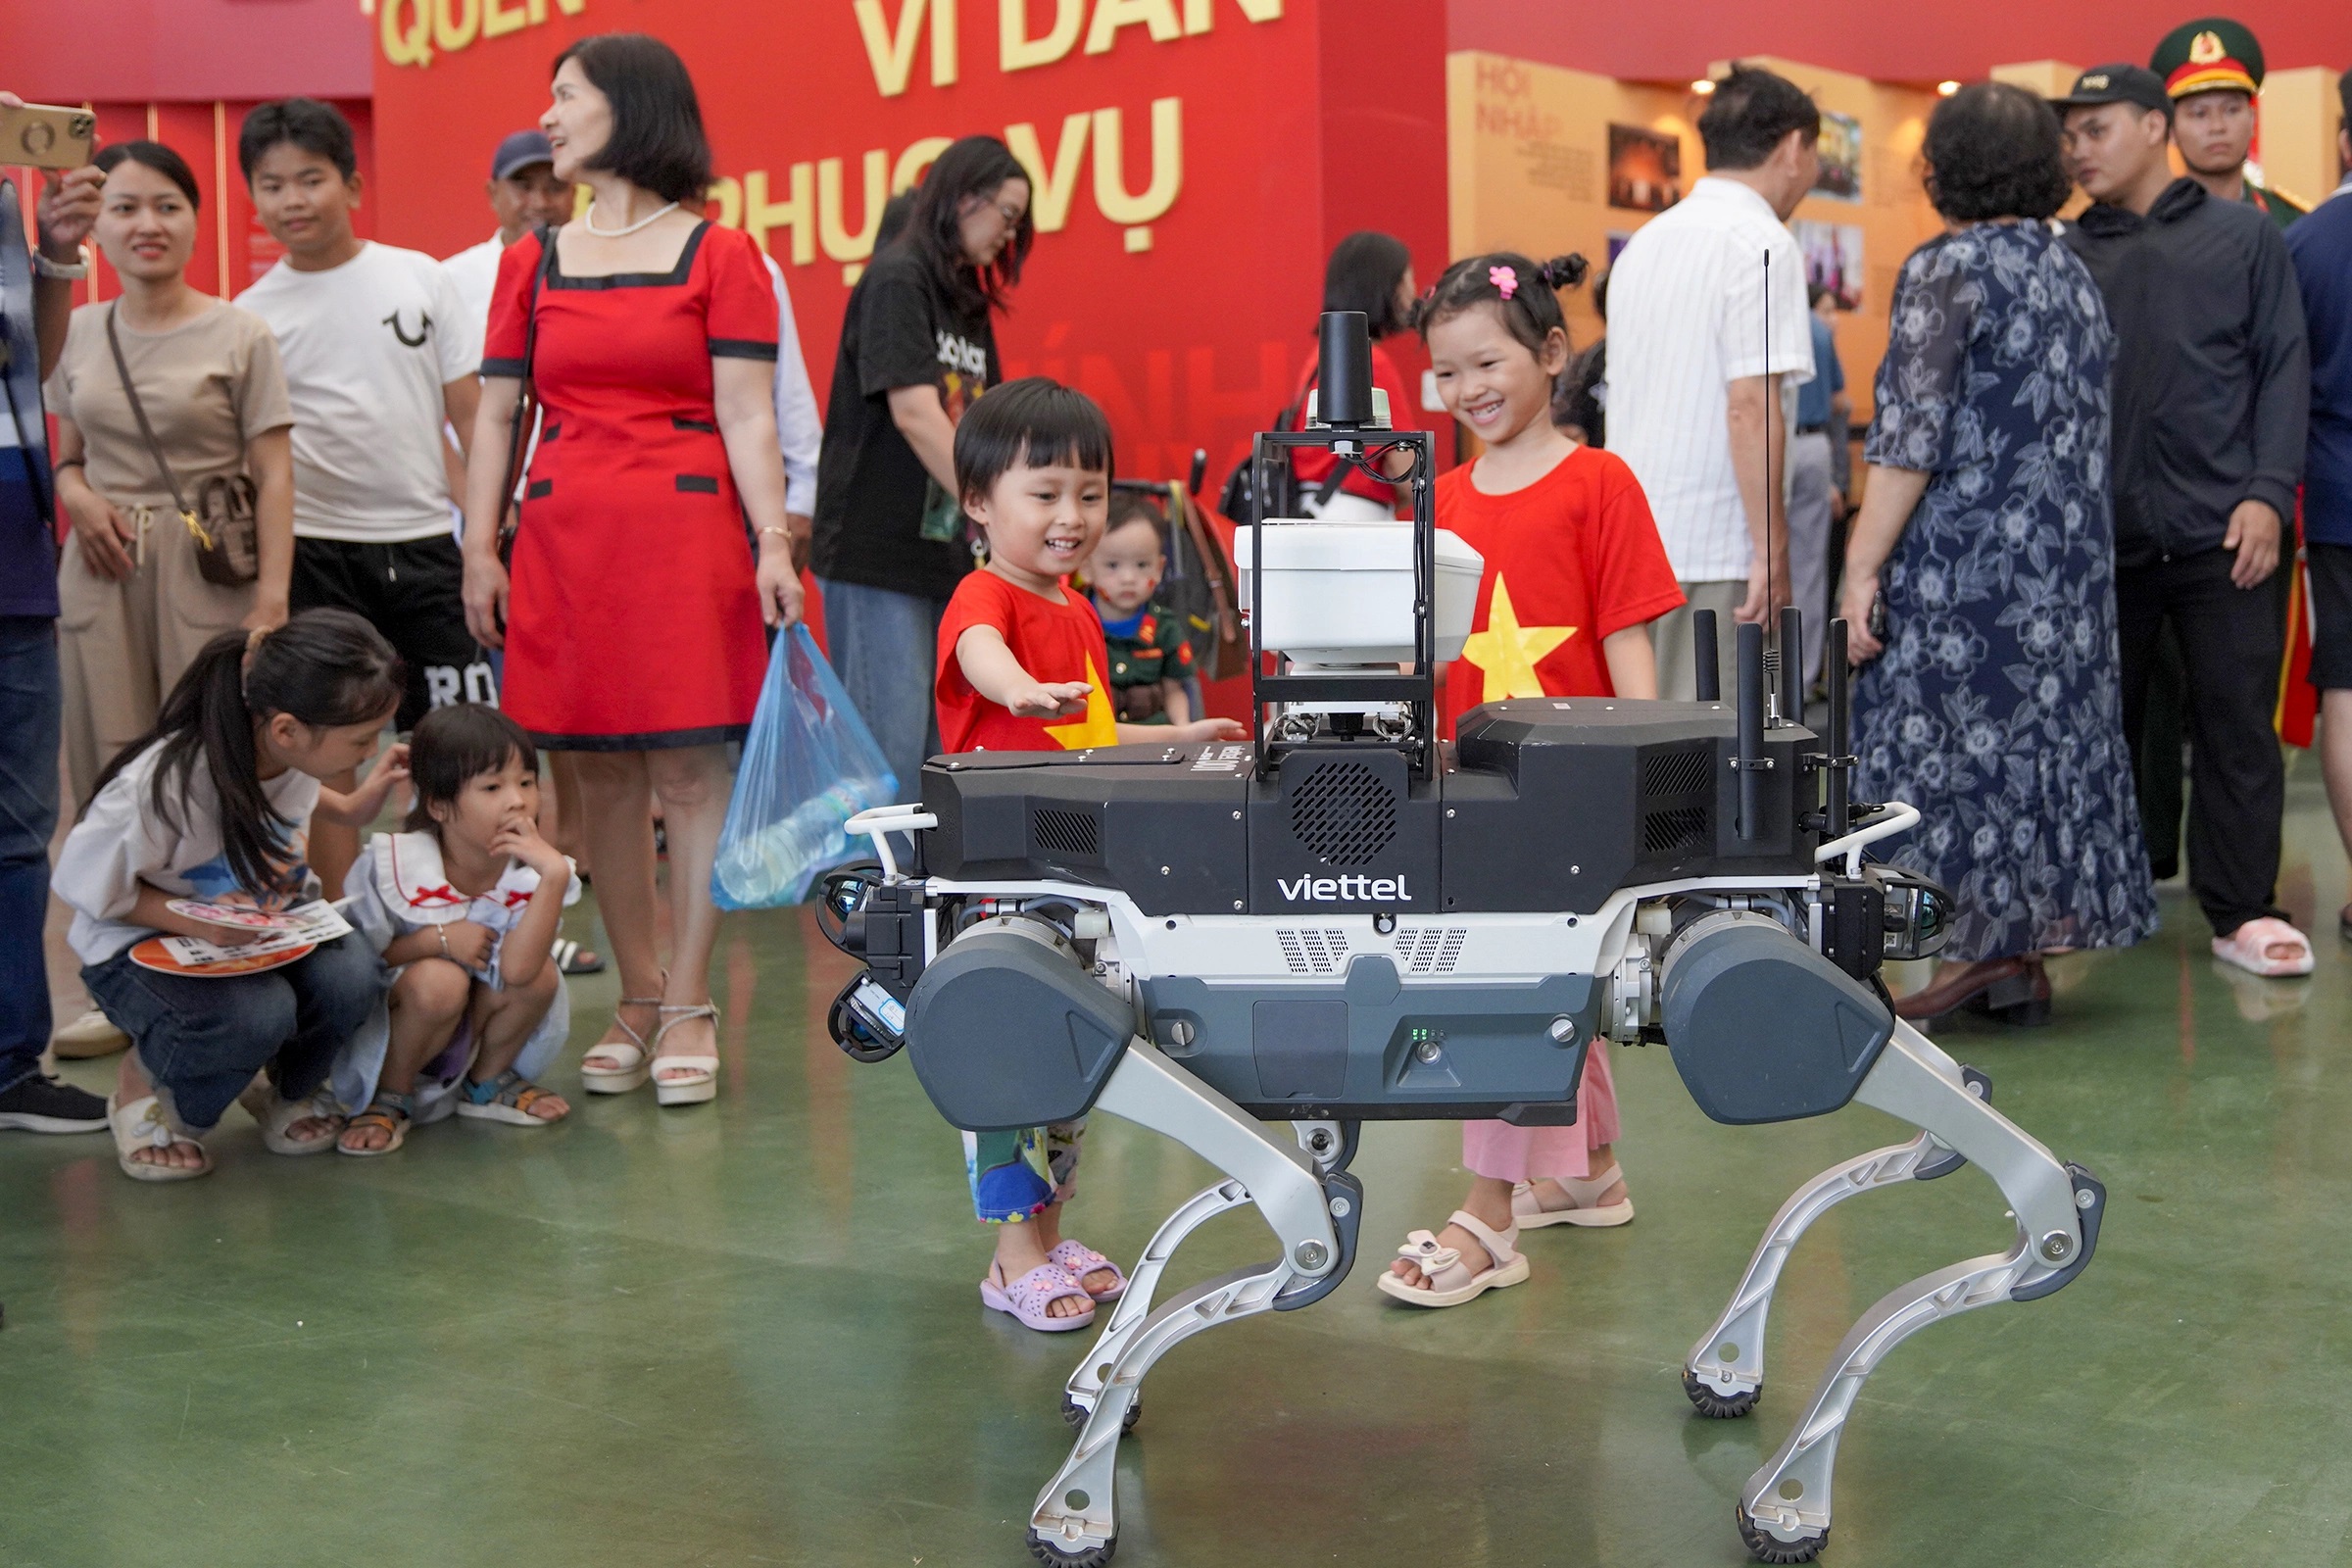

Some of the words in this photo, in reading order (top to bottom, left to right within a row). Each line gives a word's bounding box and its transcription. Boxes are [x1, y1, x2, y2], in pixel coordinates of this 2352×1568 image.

[381, 0, 586, 68] QU
[1004, 97, 1183, 253] VỤ
[1277, 873, 1412, 901] viettel
